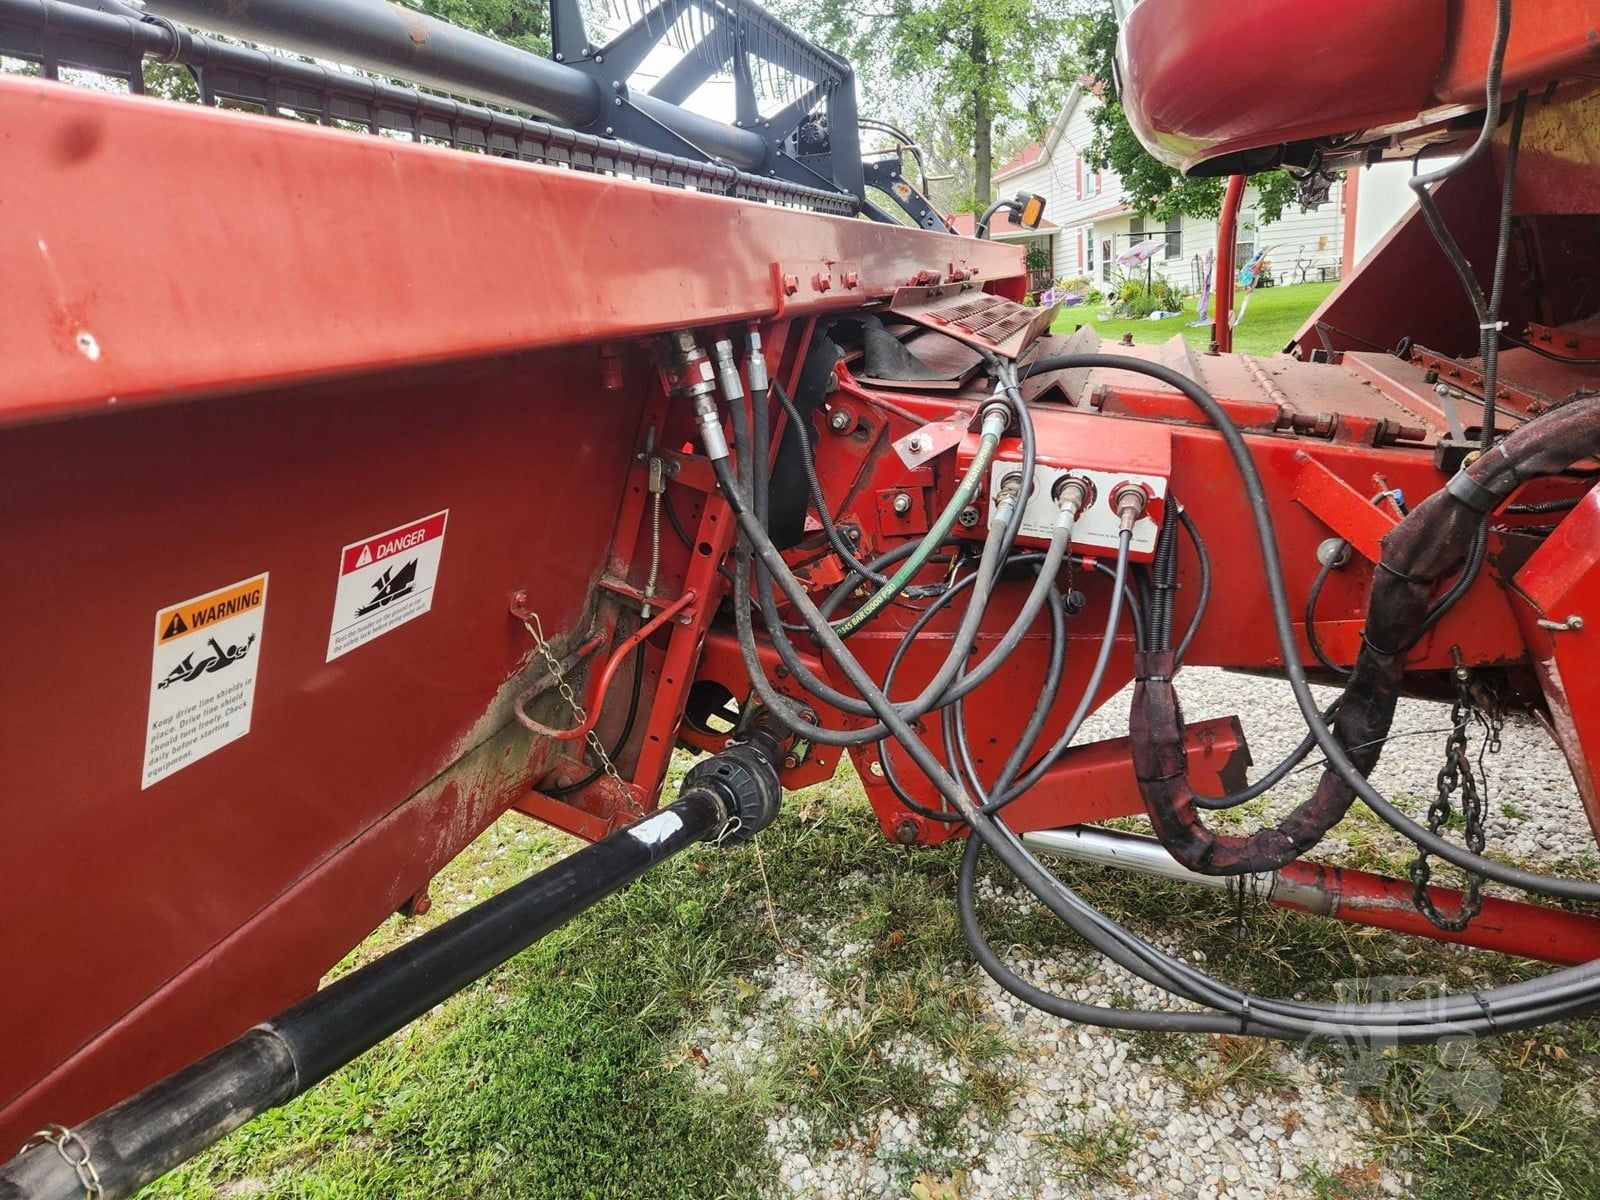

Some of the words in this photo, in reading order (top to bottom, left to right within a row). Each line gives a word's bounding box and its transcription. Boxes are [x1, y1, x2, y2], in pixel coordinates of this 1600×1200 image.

[377, 529, 426, 560] DANGER
[191, 589, 260, 628] WARNING
[851, 612, 866, 626] BAR
[151, 727, 176, 744] place.
[179, 713, 201, 728] Drive
[203, 705, 218, 717] line
[220, 691, 243, 709] shield
[152, 715, 173, 730] Keep
[176, 704, 197, 719] drive
[199, 696, 214, 708] line
[216, 683, 243, 700] shields
[245, 677, 252, 686] in
[149, 751, 170, 766] daily
[172, 736, 198, 754] before
[200, 720, 230, 740] starting
[150, 734, 178, 754] should
[180, 726, 196, 739] turn
[225, 701, 247, 717] Check
[147, 750, 193, 778] equipment.
